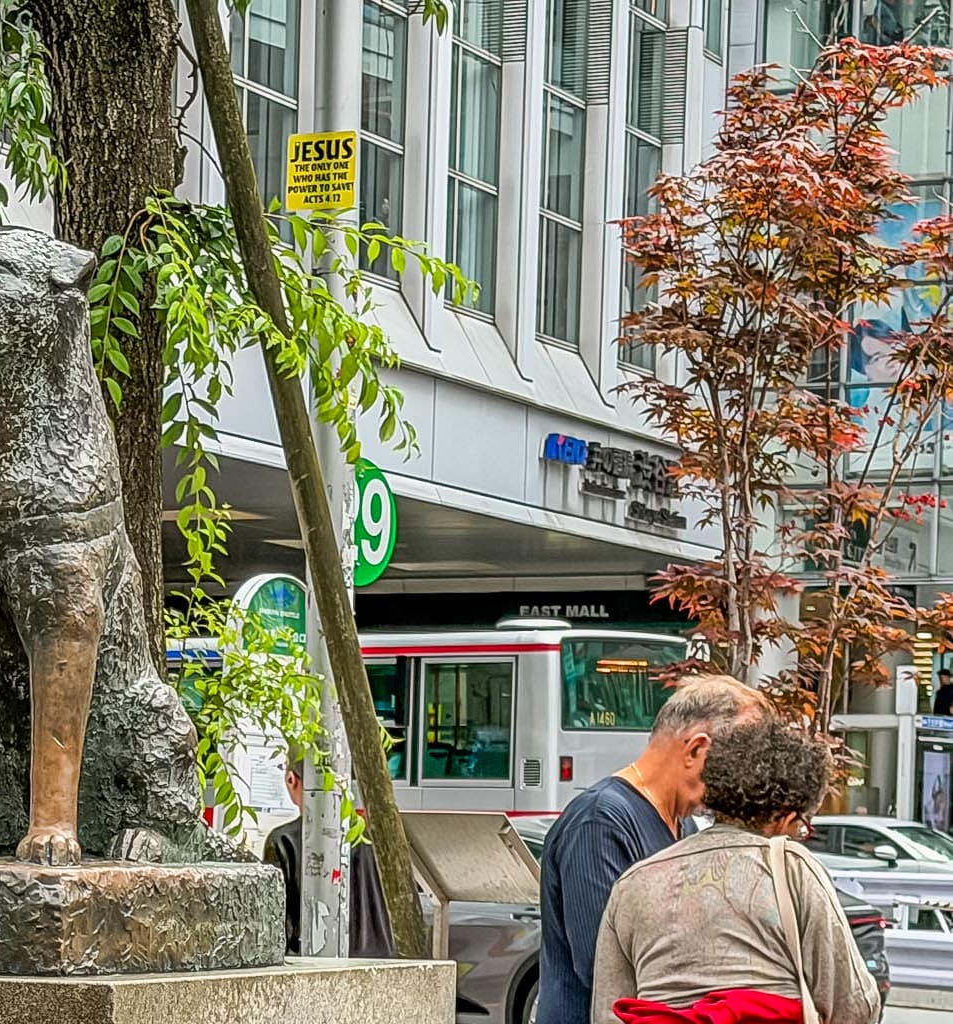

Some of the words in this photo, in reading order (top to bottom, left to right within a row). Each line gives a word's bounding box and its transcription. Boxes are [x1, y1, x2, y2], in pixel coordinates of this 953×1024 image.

[290, 138, 353, 163] JESUS
[295, 163, 310, 172] THE
[311, 162, 332, 171] ONLY
[333, 161, 349, 170] ONE
[293, 174, 313, 183] WHO
[315, 173, 331, 182] HAS
[333, 172, 348, 181] THE
[287, 184, 317, 194] POWER
[319, 183, 330, 193] TO
[303, 194, 324, 204] ACTS
[519, 605, 561, 617] EAST
[566, 604, 609, 618] MALL
